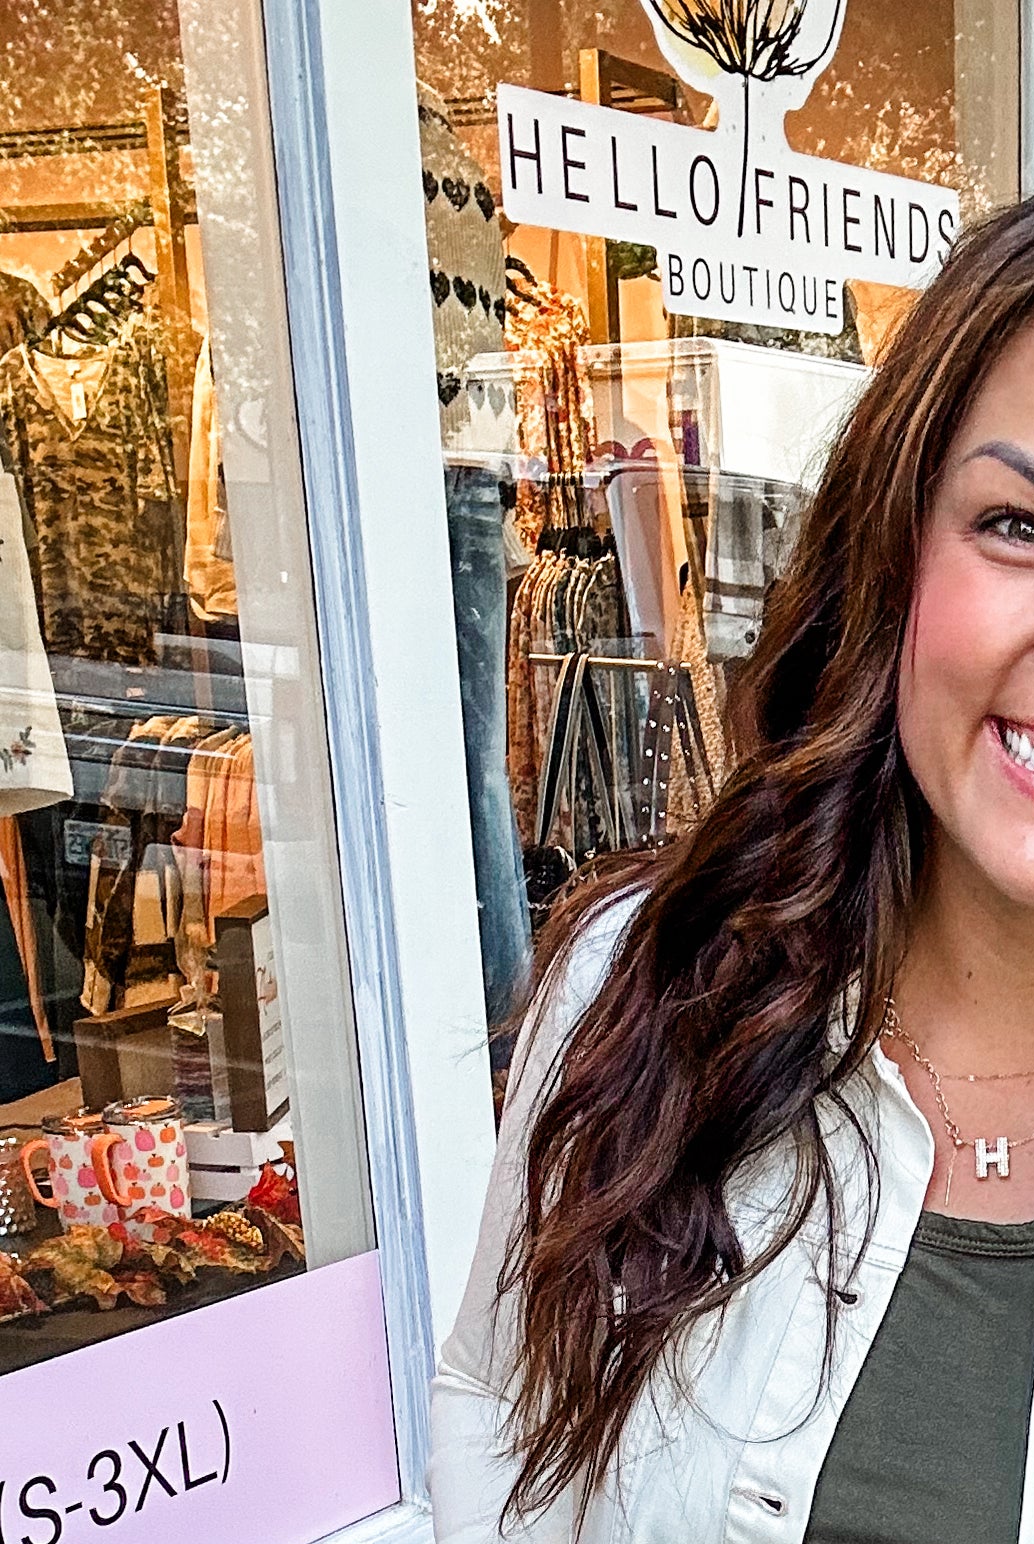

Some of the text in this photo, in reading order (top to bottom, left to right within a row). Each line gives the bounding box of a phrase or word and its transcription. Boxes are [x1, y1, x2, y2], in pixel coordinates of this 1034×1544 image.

[507, 113, 954, 265] HELLO FRIENDS
[668, 253, 838, 319] BOUTIQUE
[975, 1136, 1009, 1179] H
